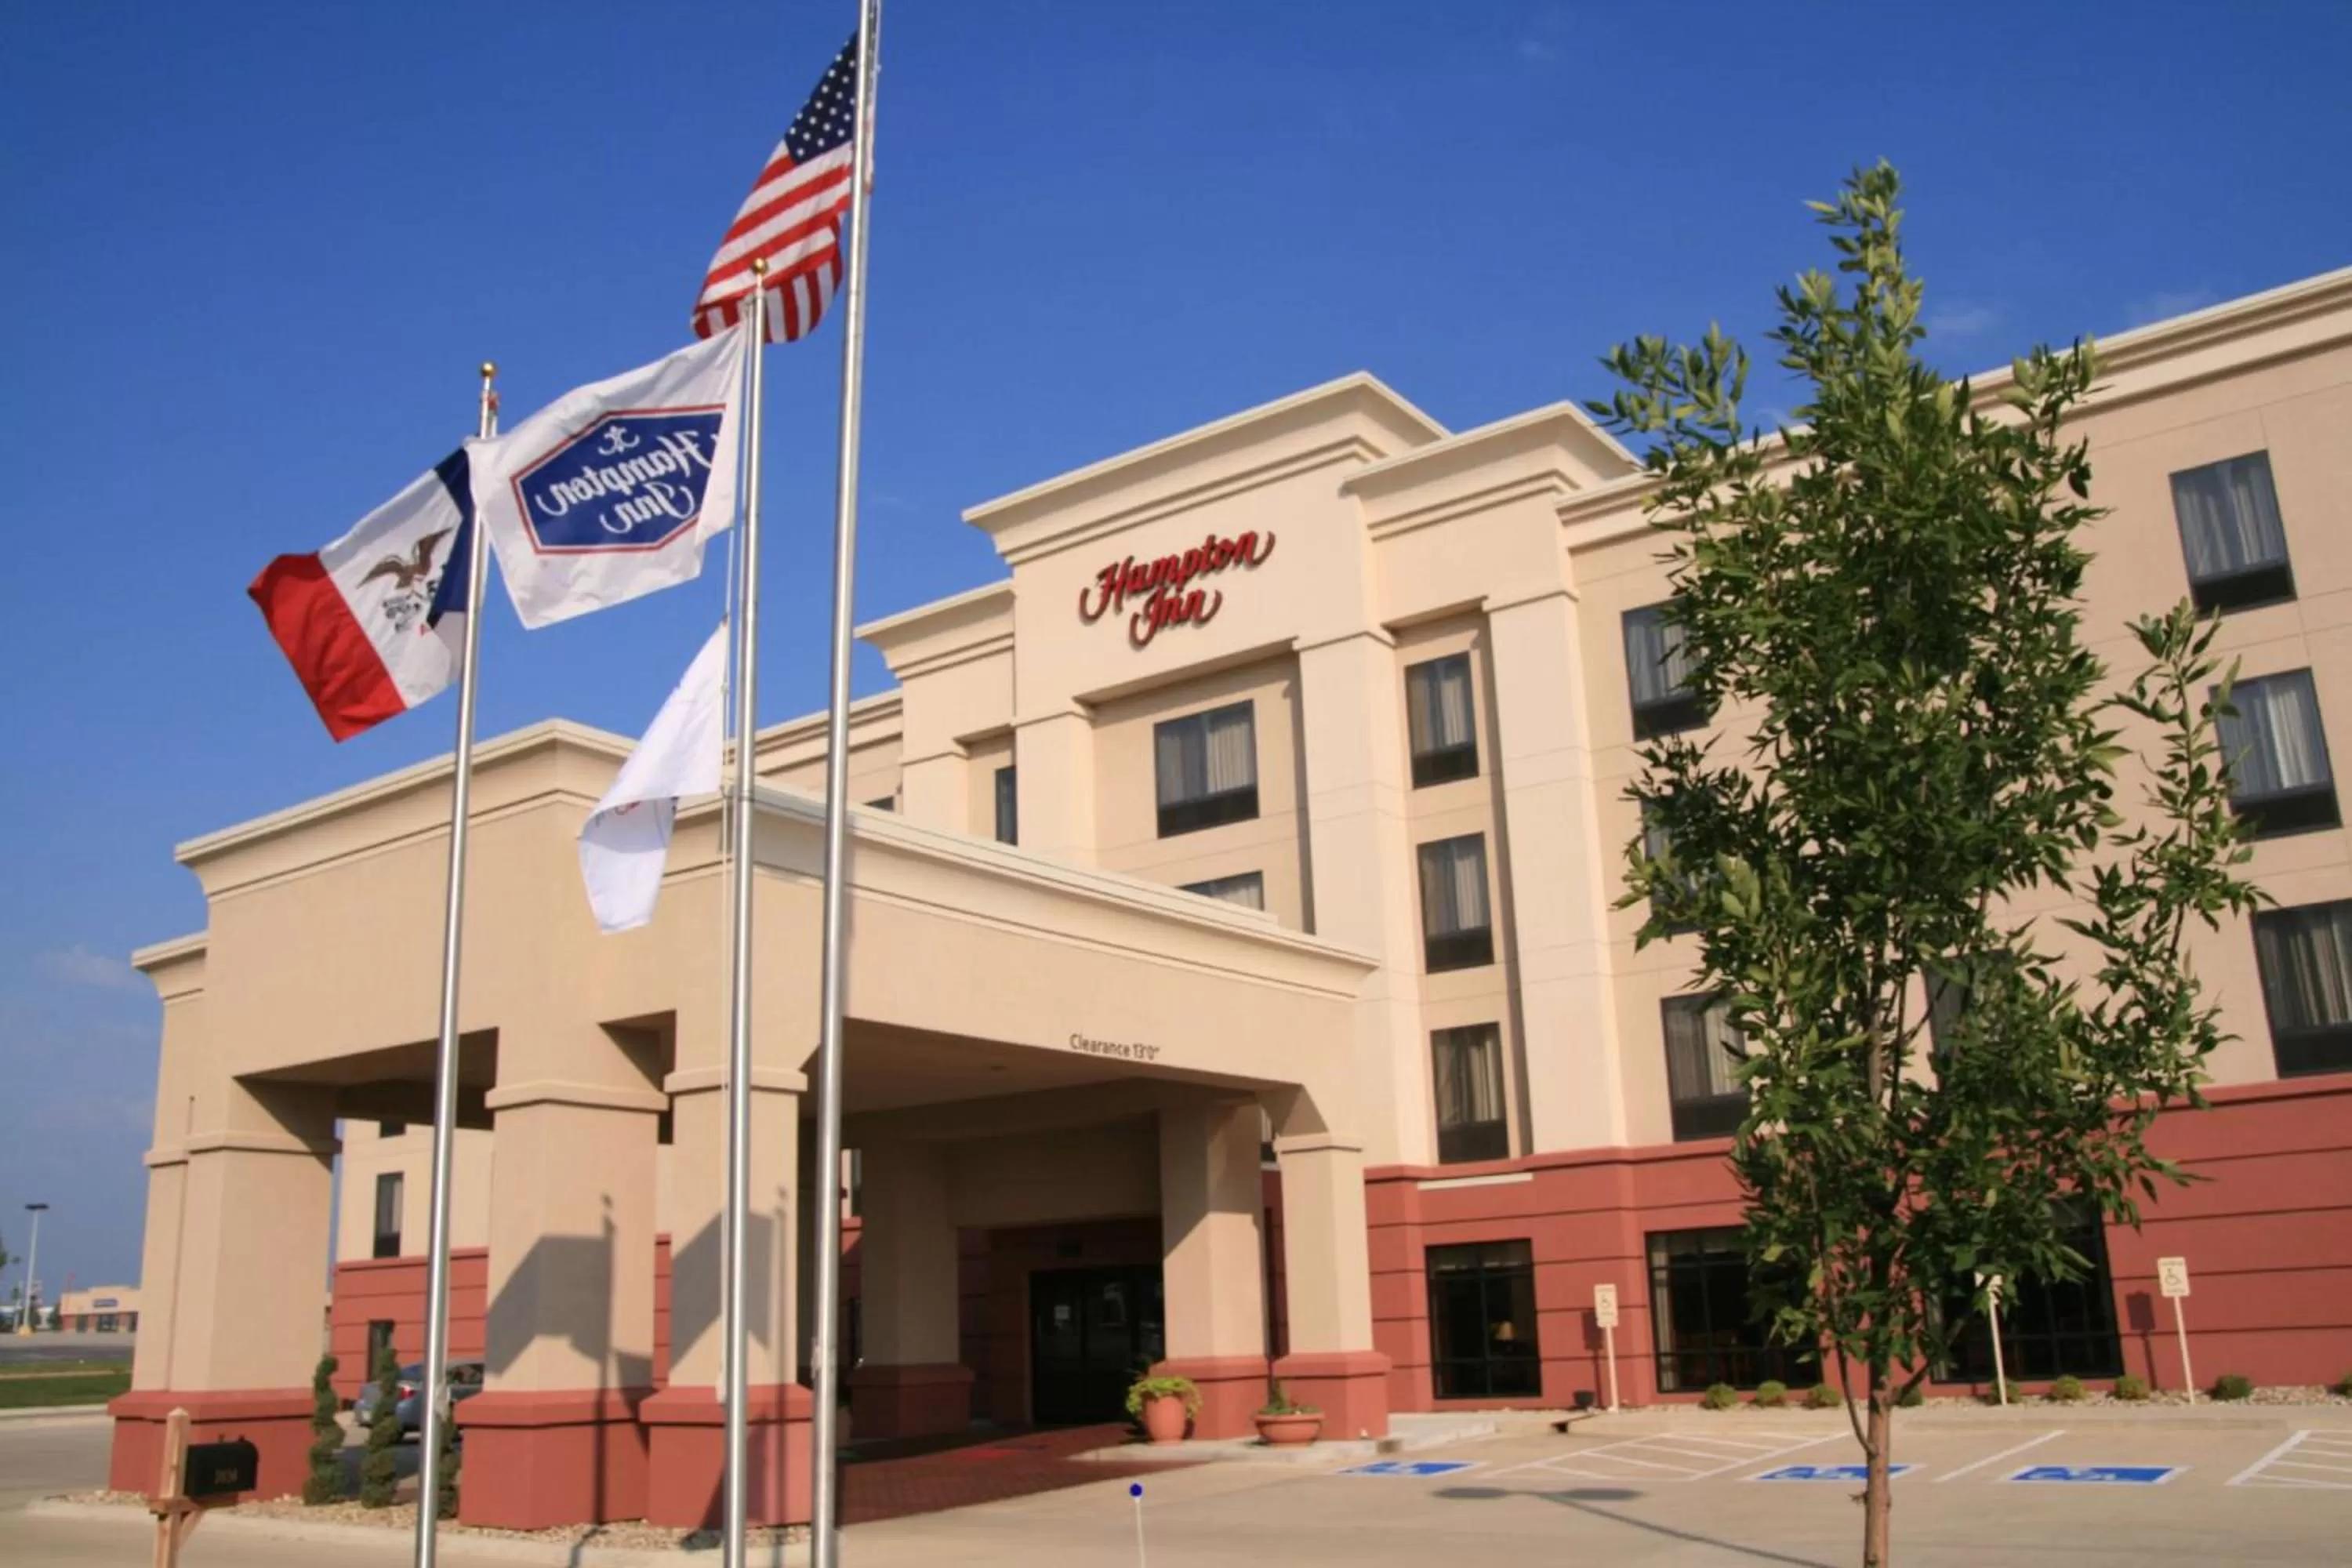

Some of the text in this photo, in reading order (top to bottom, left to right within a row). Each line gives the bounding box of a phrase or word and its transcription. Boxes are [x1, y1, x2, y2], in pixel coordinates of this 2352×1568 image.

[1078, 530, 1276, 622] Hampton
[1129, 586, 1223, 648] Inn
[1069, 1033, 1131, 1058] Clearance
